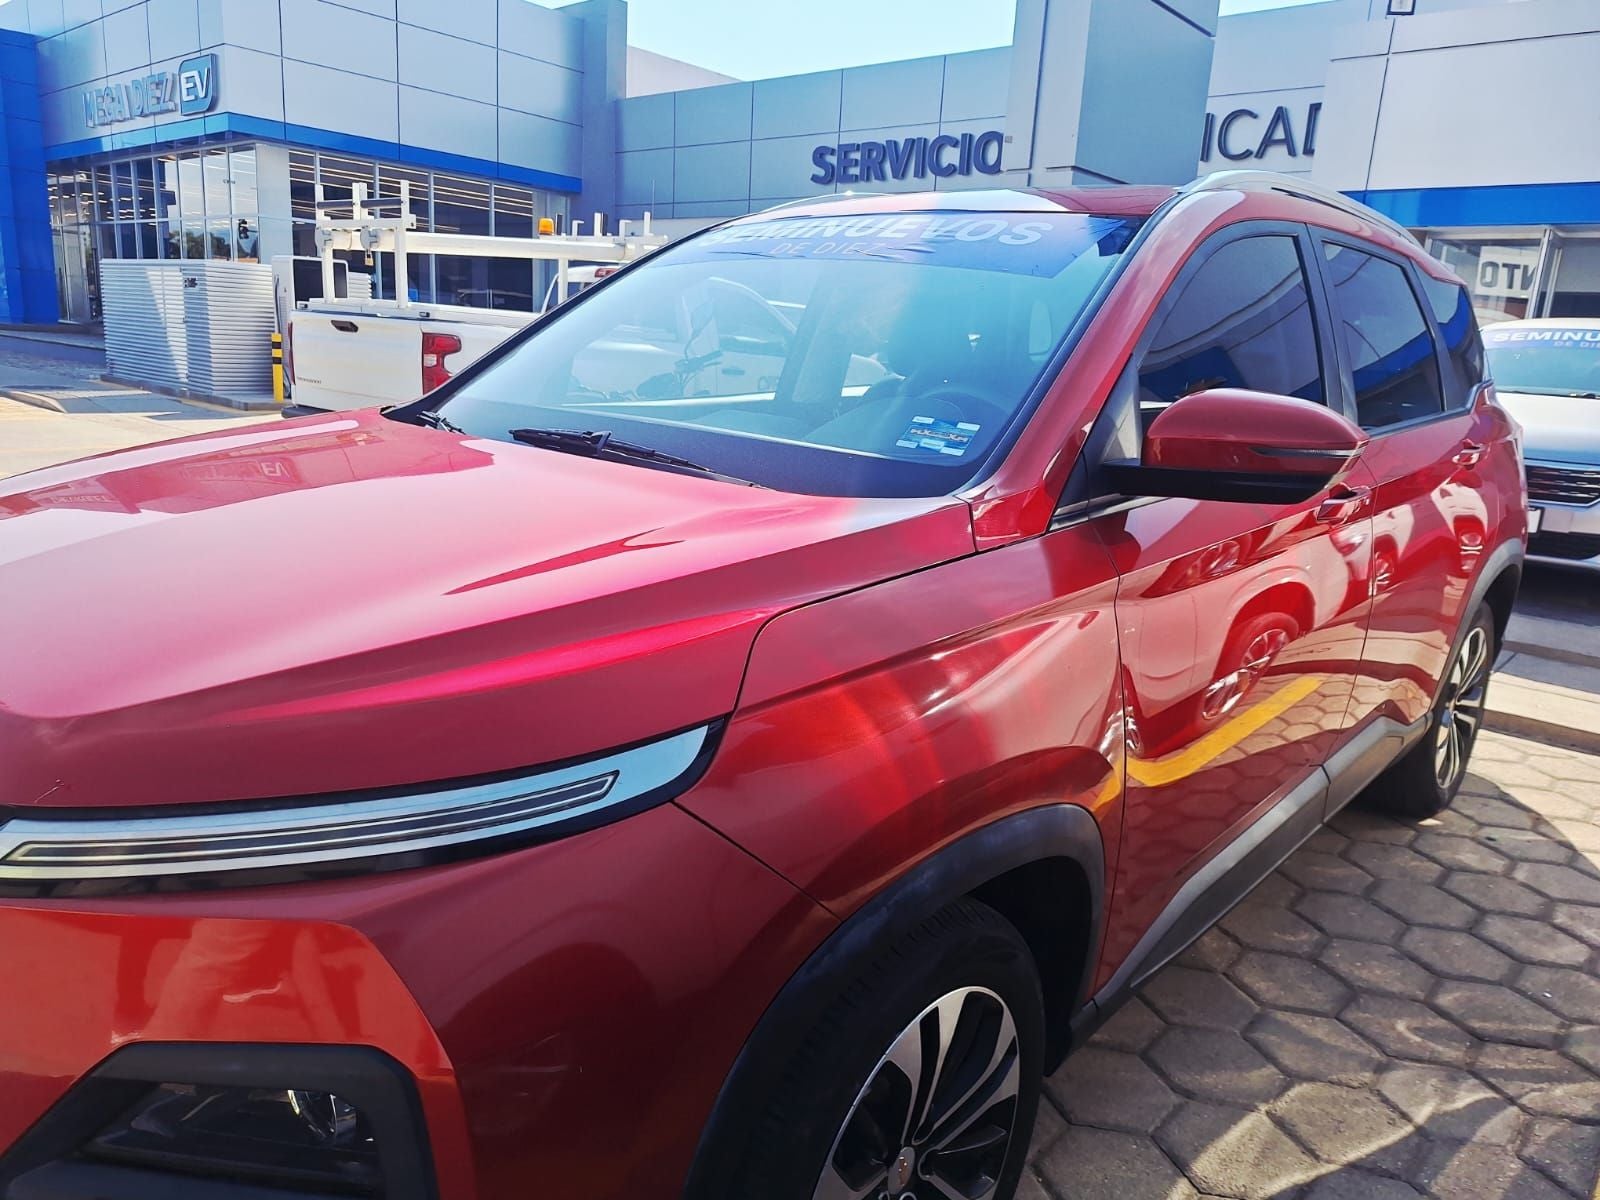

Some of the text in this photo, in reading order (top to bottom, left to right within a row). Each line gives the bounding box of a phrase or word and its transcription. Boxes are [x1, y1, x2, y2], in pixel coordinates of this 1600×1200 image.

[83, 67, 210, 128] MEGA DIEZ EV
[811, 131, 1003, 185] SERVICIO
[701, 217, 1054, 247] SEMINUEVOS
[769, 242, 811, 254] DE
